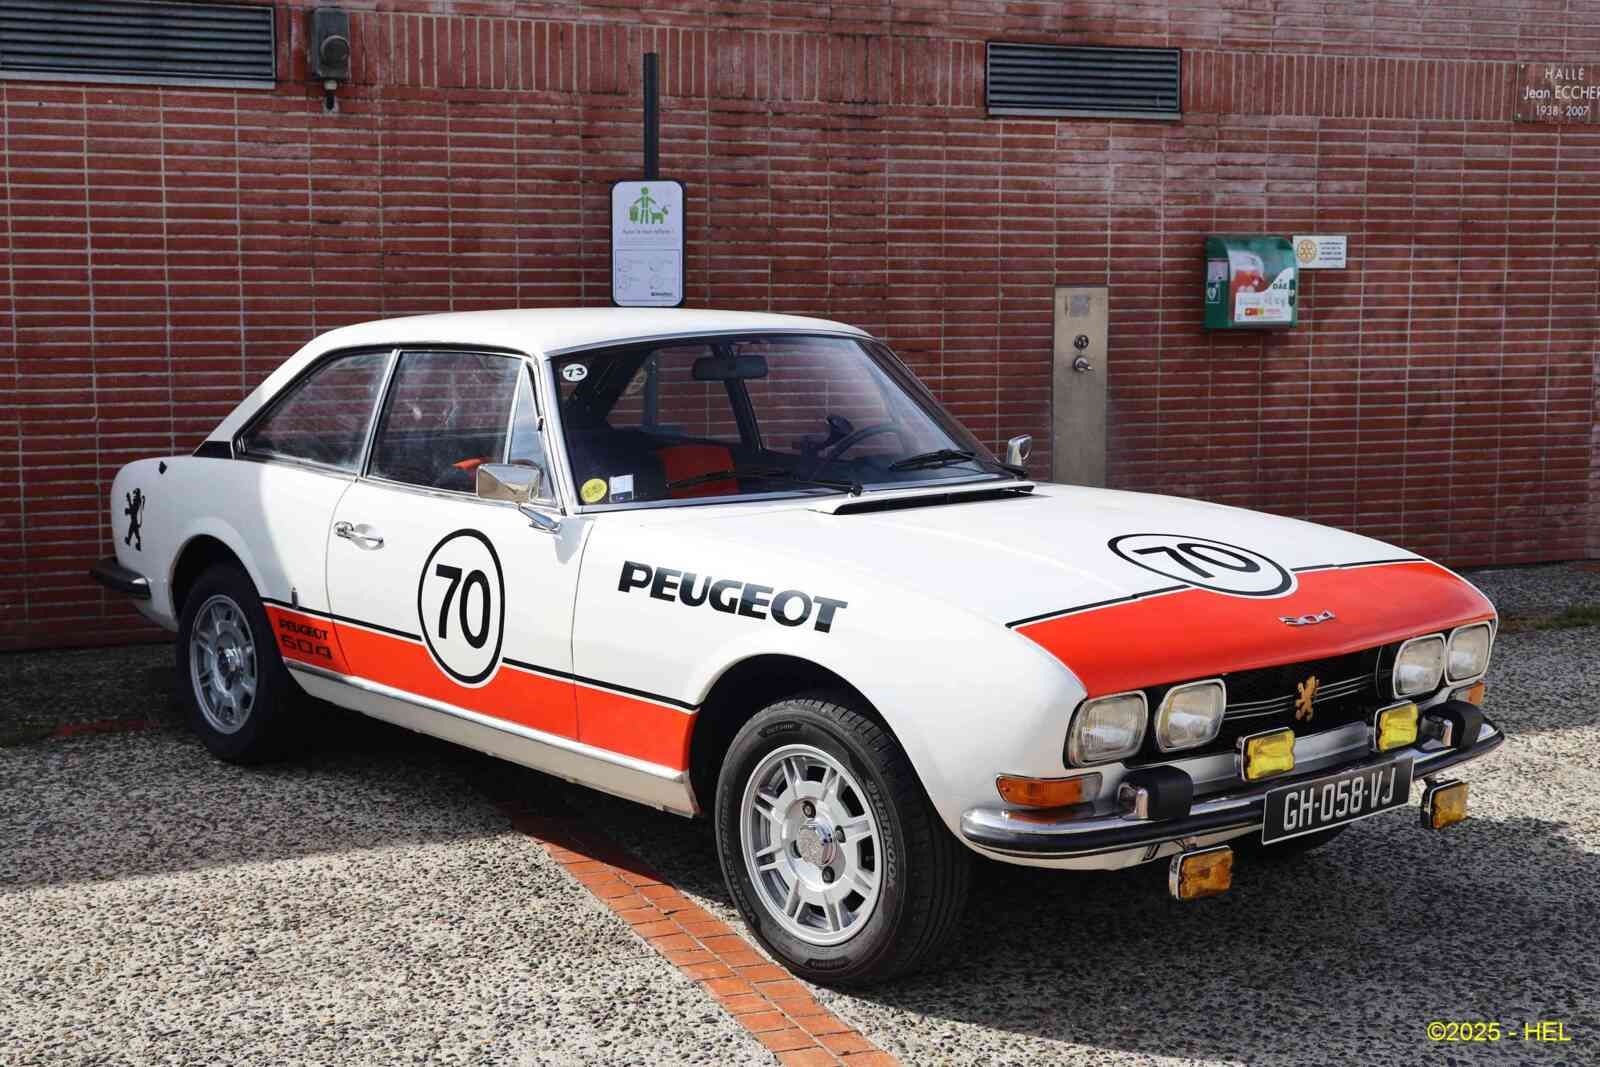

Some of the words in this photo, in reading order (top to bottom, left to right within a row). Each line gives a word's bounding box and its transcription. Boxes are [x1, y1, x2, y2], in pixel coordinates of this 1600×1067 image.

[1545, 67, 1584, 81] HALLE
[1524, 85, 1551, 101] Jean
[1566, 105, 1591, 117] 2007
[565, 367, 585, 377] 73
[1132, 542, 1260, 579] 70
[435, 563, 492, 649] 70
[618, 560, 849, 634] PEUGEOT
[1279, 609, 1337, 626] 504
[279, 619, 329, 641] PEUGEOT
[281, 634, 333, 660] 504
[1283, 767, 1397, 832] GH-058-VJ
